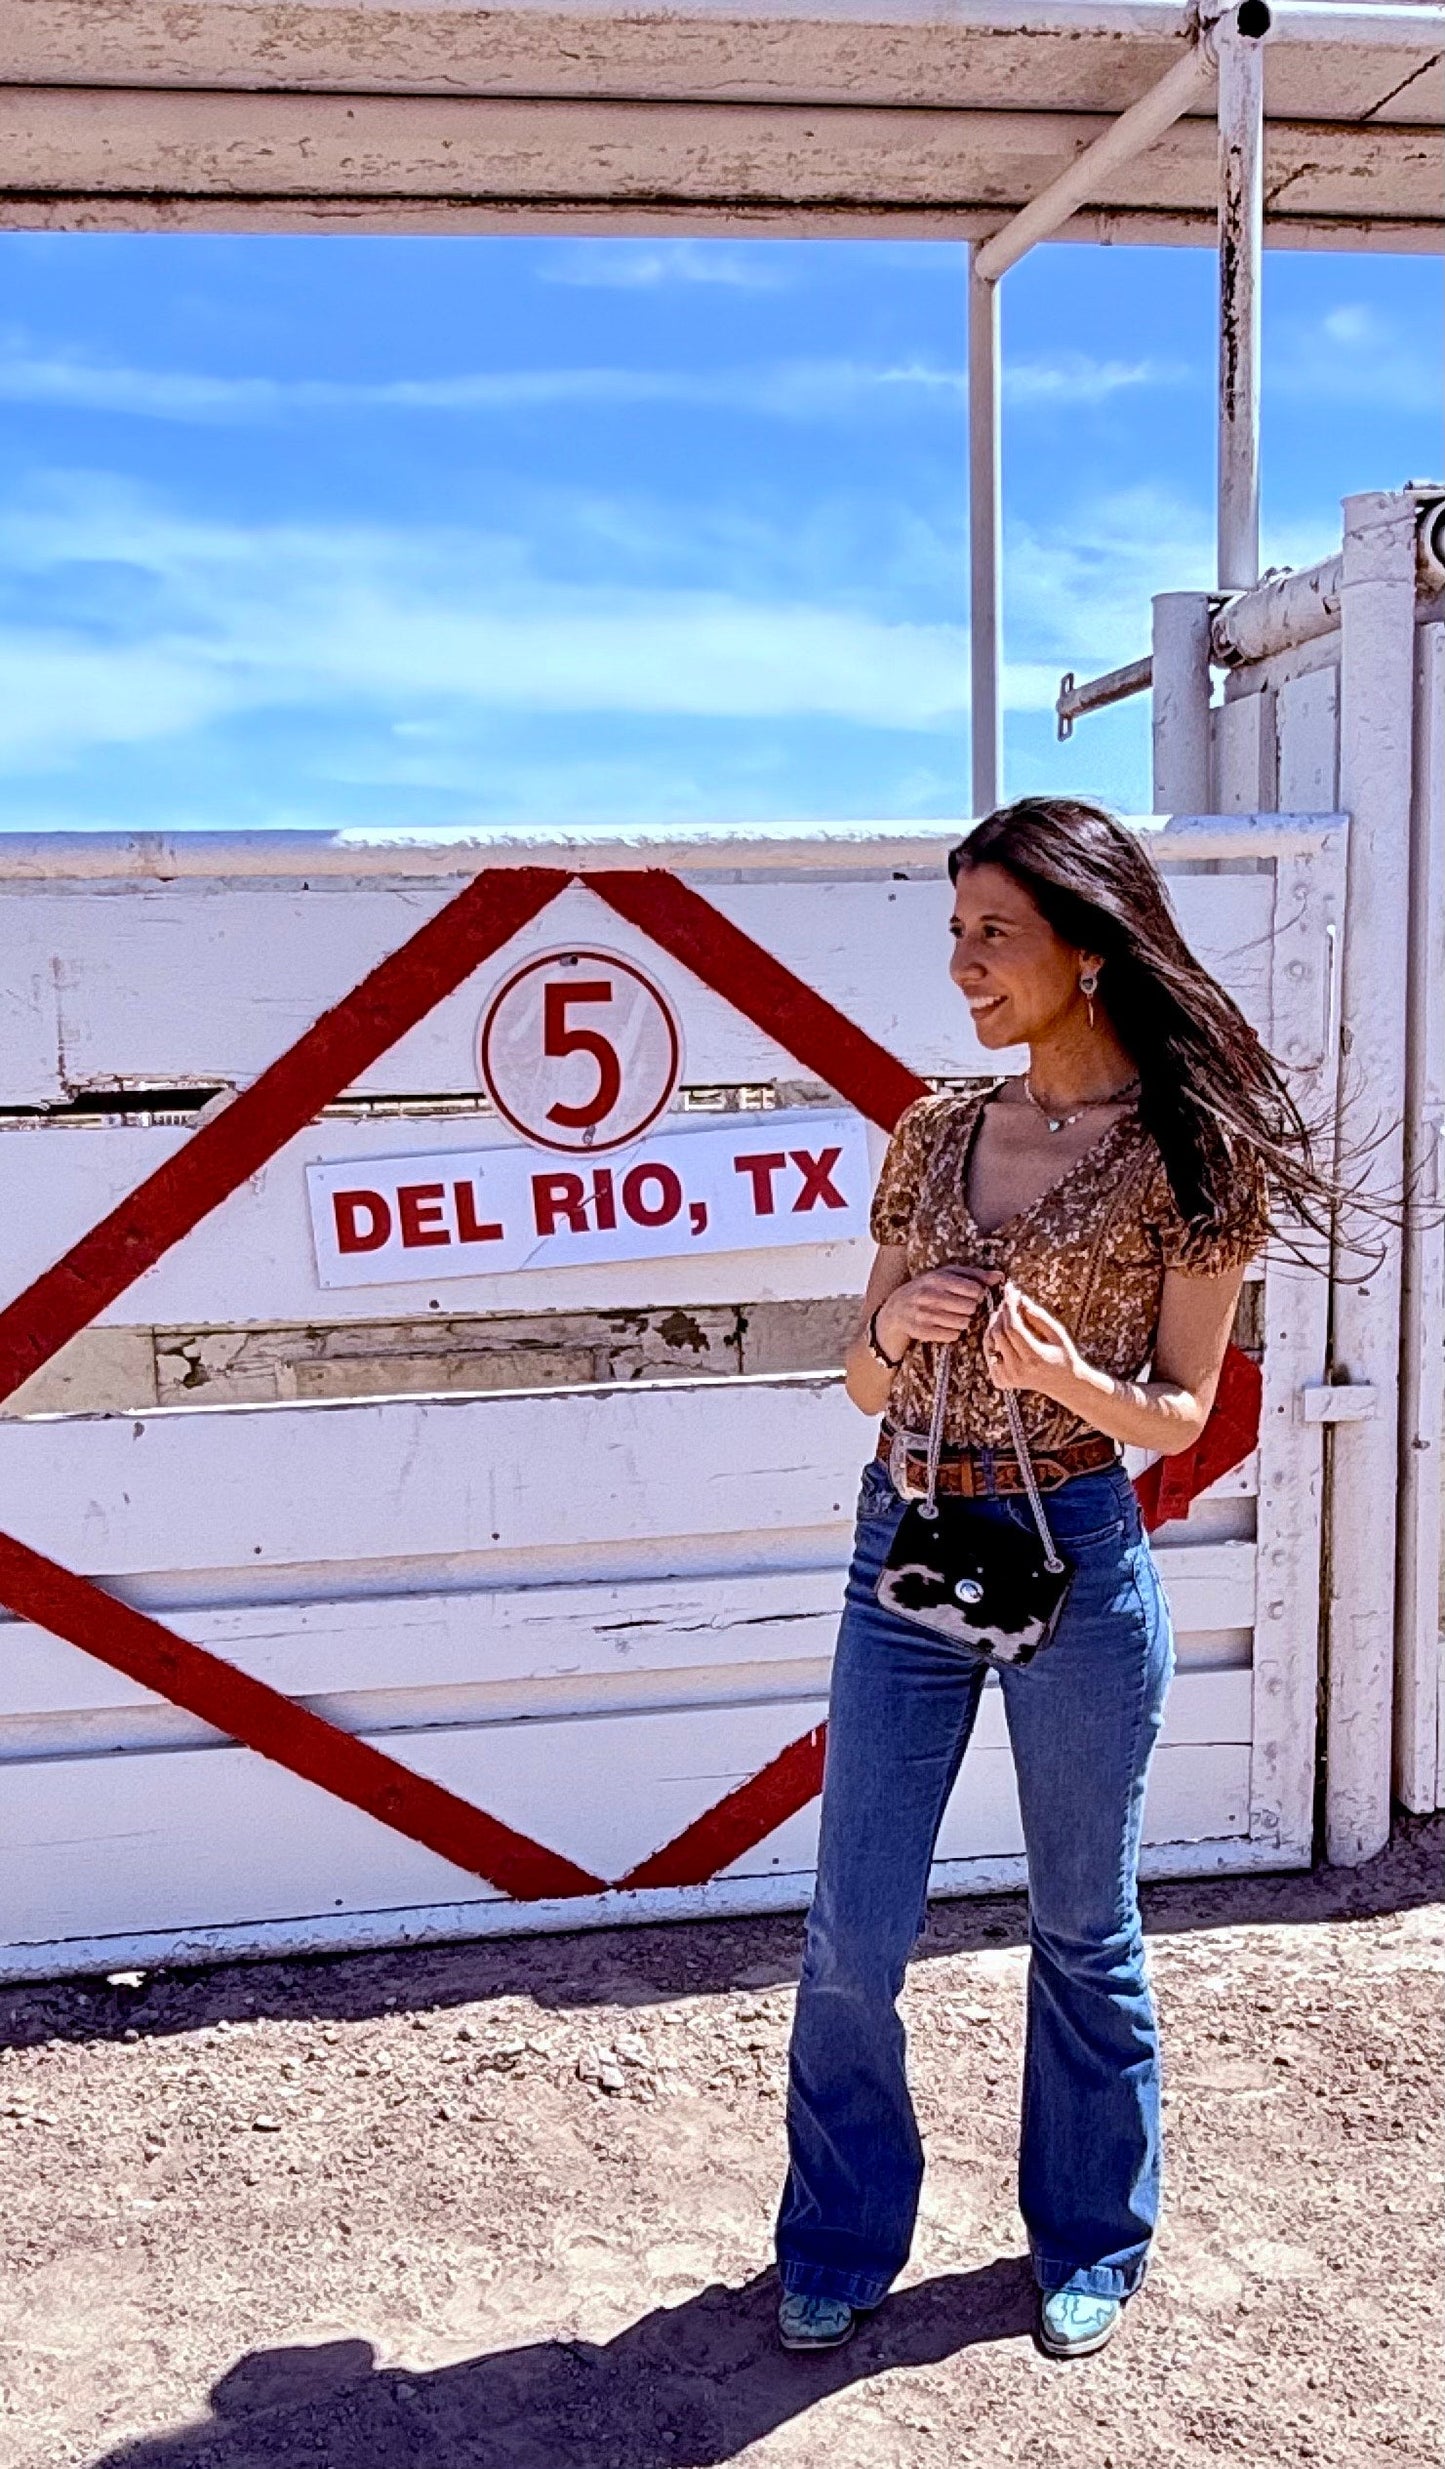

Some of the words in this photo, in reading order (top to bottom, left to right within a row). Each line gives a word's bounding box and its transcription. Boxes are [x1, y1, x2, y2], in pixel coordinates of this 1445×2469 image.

[543, 980, 621, 1128] 5
[333, 1181, 503, 1254] DEL
[532, 1163, 707, 1236] RIO,
[734, 1147, 847, 1215] TX
